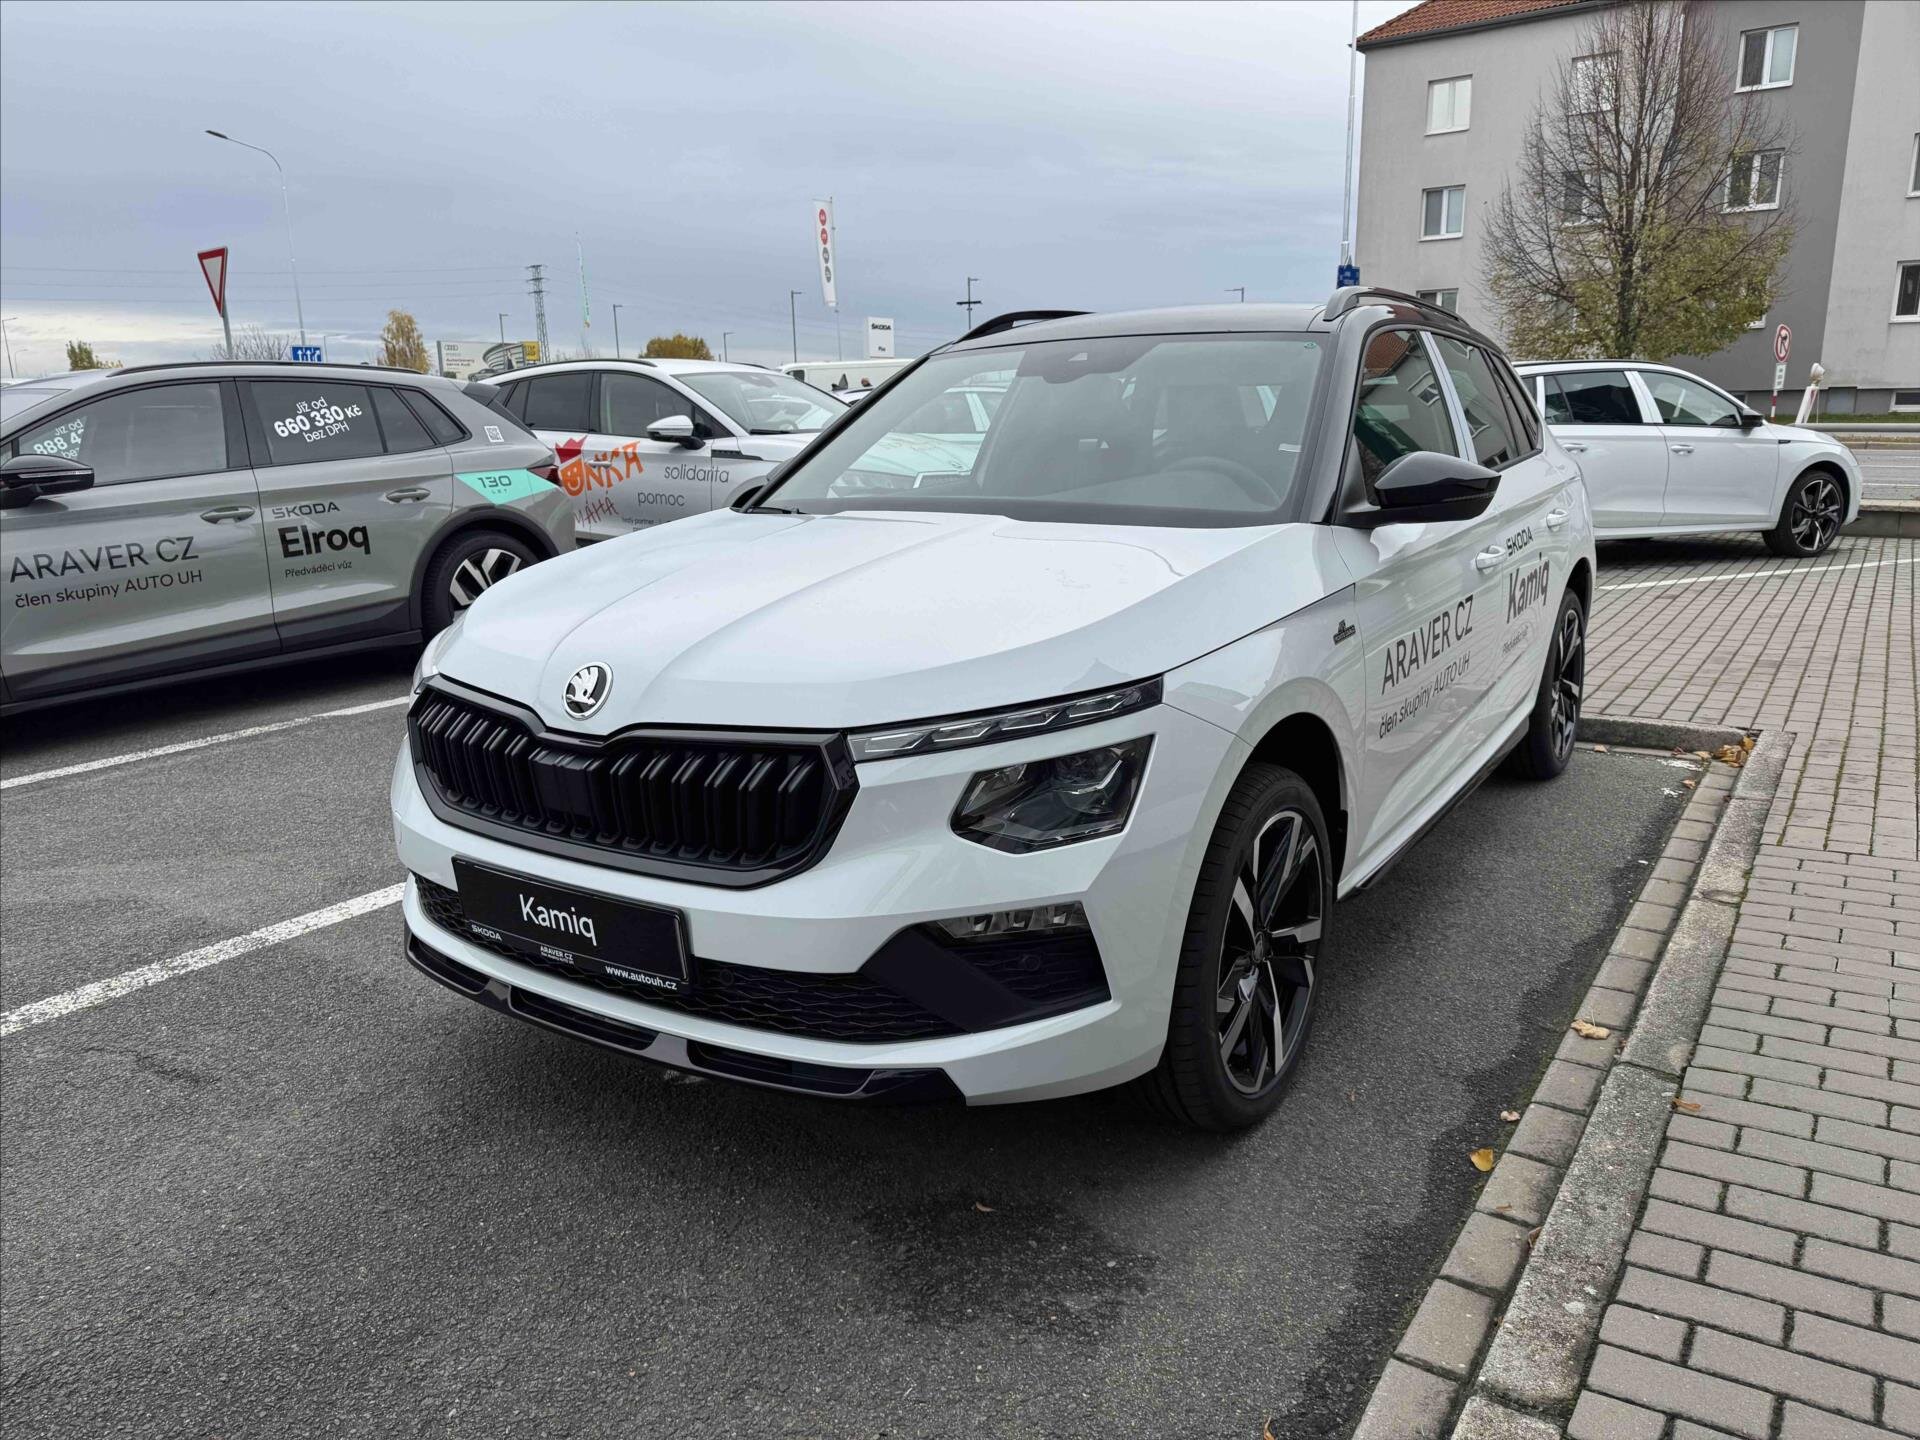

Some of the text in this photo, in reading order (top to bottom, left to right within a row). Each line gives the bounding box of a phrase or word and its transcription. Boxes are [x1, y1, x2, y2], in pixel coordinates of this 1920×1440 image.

[296, 396, 328, 414] Již od
[68, 419, 83, 430] od
[273, 404, 363, 438] 660 330 Kč
[302, 420, 351, 443] bez DPH
[477, 475, 512, 489] 130
[664, 463, 730, 484] solidarita
[637, 491, 686, 508] pomoc
[277, 525, 371, 558] Elroq
[9, 536, 200, 584] ARAVER CZ
[337, 559, 353, 570] vůz
[15, 569, 203, 608] člen skupiny AUTO UH
[1506, 551, 1550, 625] Kamiq
[1381, 610, 1451, 696] ARAVER
[1454, 594, 1474, 642] CZ
[1379, 650, 1471, 740] člen skupiny AUTO UH
[519, 893, 598, 947] Kamiq
[564, 952, 574, 961] CZ
[604, 965, 678, 991] www.autouh.cz
